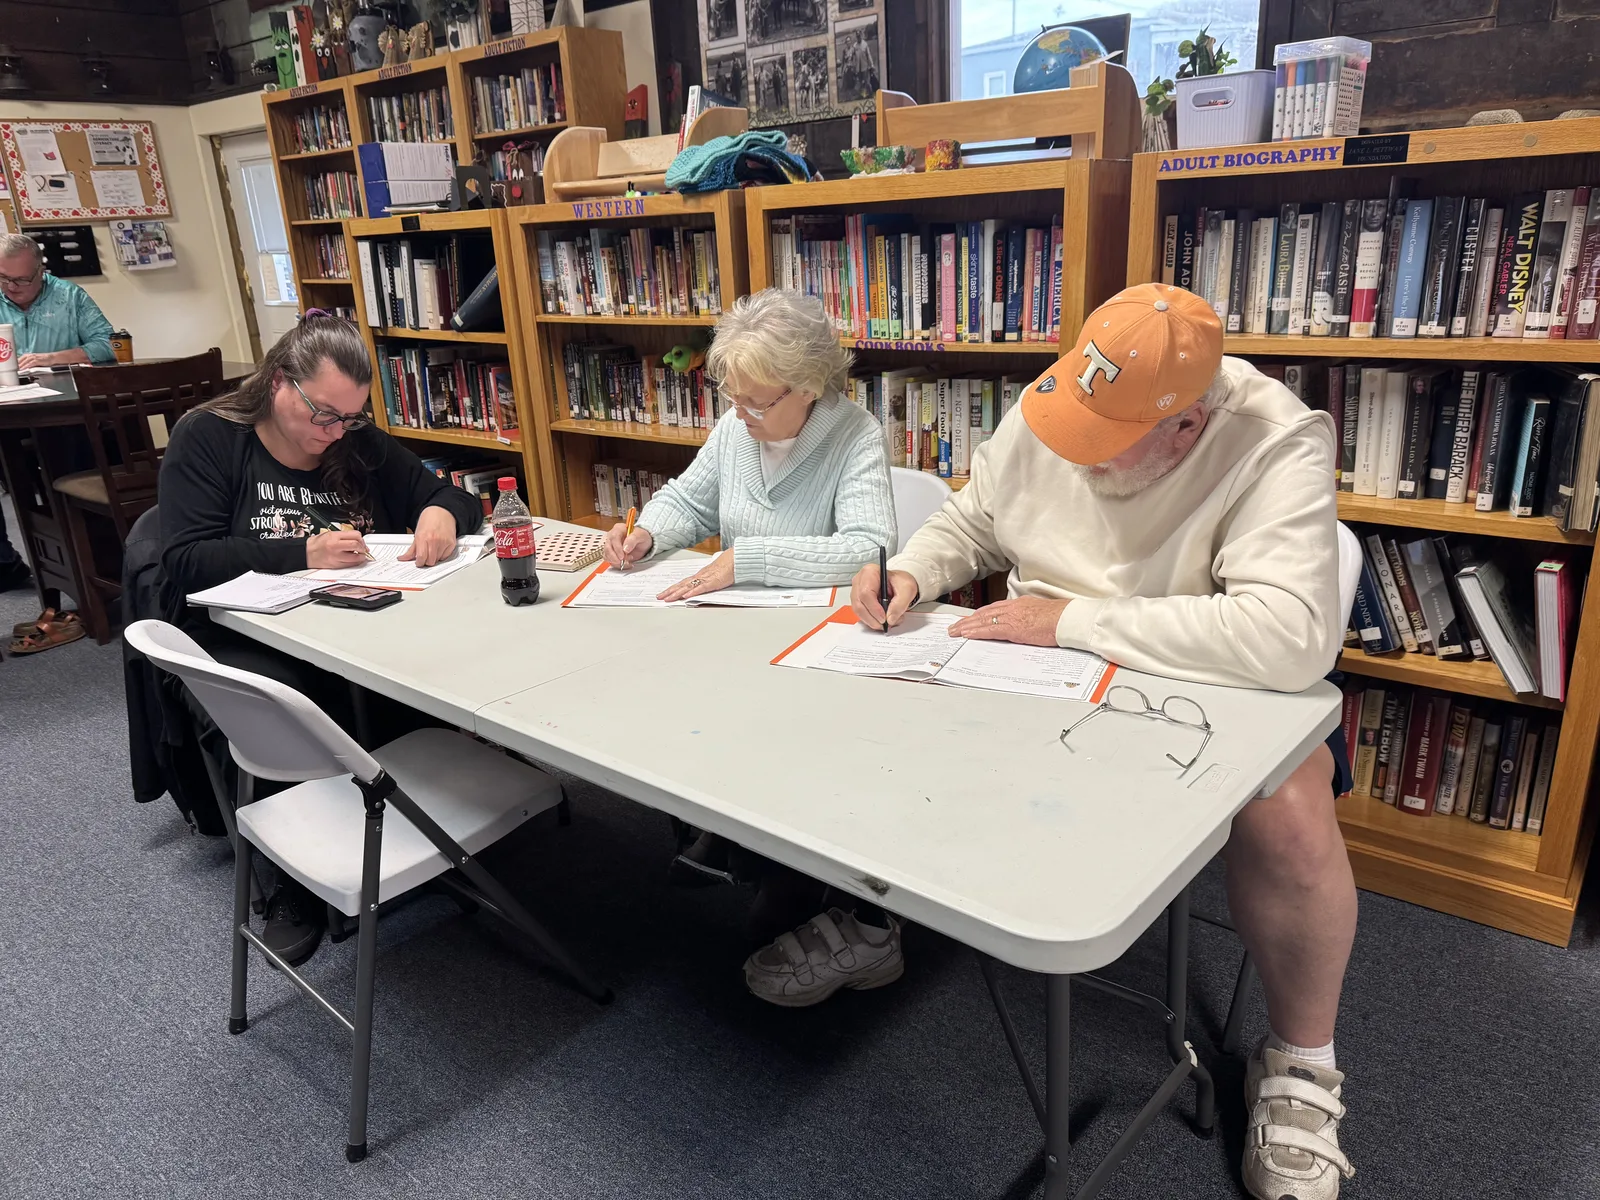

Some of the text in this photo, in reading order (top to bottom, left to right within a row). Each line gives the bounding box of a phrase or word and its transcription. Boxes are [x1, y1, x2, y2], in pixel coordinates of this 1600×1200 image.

[484, 37, 526, 57] ADULT FICTION
[378, 63, 412, 80] ADULT FICTION
[301, 84, 318, 96] FICTION
[1159, 146, 1342, 172] ADULT BIOGRAPHY
[572, 199, 645, 219] WESTERN
[1410, 206, 1421, 238] Kellyanne
[996, 246, 1004, 264] Slice
[1182, 230, 1193, 264] JOHN
[1406, 238, 1417, 264] Conway
[1460, 226, 1479, 272] CUSTER
[1504, 235, 1515, 258] NEAL
[1508, 202, 1540, 314] WALT DISNEY
[1582, 232, 1596, 271] WALTER
[996, 265, 1004, 273] of
[1276, 233, 1294, 289] LAURA BUSH
[1295, 231, 1308, 298] THE PERFECT WIFE
[969, 253, 978, 298] skinnytaste
[1337, 264, 1350, 295] CASH
[1403, 275, 1412, 294] Here's
[1499, 261, 1511, 295] GABLER
[914, 273, 922, 305] HEALTHY
[1032, 255, 1042, 326] MADE AMERICA
[1053, 266, 1064, 321] AMERICA
[1402, 295, 1410, 306] the
[1430, 271, 1442, 317] KATIE COURIC
[855, 339, 946, 352] COOKBOOKS
[1076, 339, 1122, 396] T
[939, 381, 947, 409] Super
[1461, 373, 1478, 395] THE
[1496, 381, 1506, 411] PRIYANKA
[1368, 392, 1376, 406] Steve
[1343, 395, 1359, 446] SADDAM HUSSEIN
[1367, 406, 1375, 419] Jobs
[1410, 405, 1420, 442] AMERICAN
[1455, 397, 1474, 433] OTHER
[1492, 411, 1502, 436] CHOPRA
[1532, 417, 1546, 436] River
[1408, 446, 1416, 464] LION
[1449, 436, 1469, 480] BARACK
[1489, 436, 1498, 456] JONAS
[1530, 444, 1540, 463] Time
[257, 482, 345, 506] YOU ARE BEAUTIF
[1525, 471, 1536, 500] NAOMI JUDD
[250, 516, 286, 530] STRONG
[260, 504, 302, 516] victorious
[260, 528, 297, 540] created
[494, 529, 516, 547] Cola
[1374, 546, 1404, 623] LEONARD
[1392, 561, 1406, 587] ODDS
[1360, 608, 1374, 628] NIXO
[1378, 698, 1398, 763] TIM TEBOW
[1418, 736, 1430, 757] MARK
[1414, 757, 1427, 779] TWAIN
